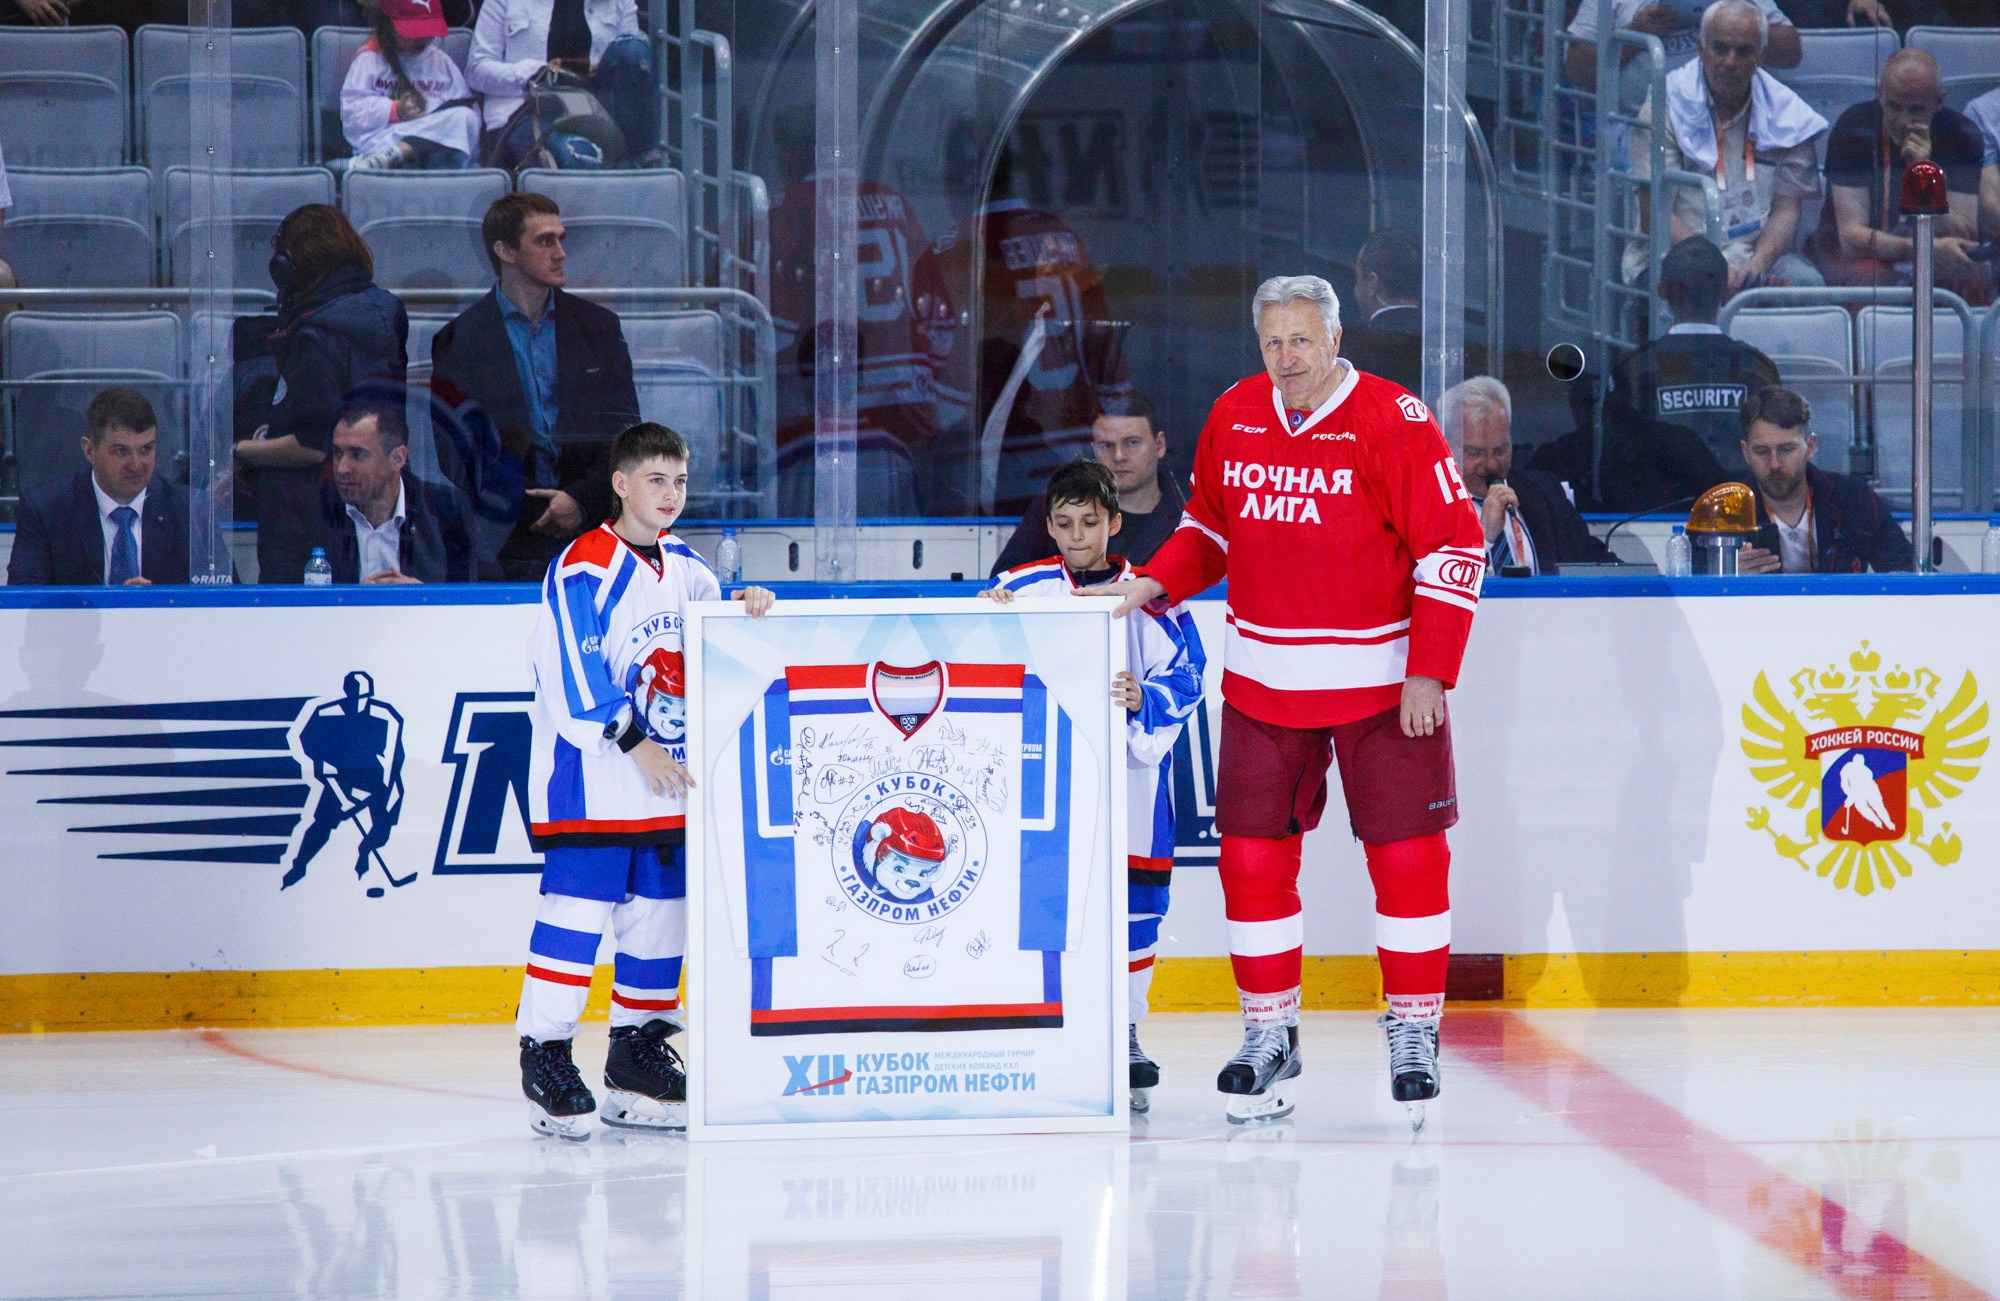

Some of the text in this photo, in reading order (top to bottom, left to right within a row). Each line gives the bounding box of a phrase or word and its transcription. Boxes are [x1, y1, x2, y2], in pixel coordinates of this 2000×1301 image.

[1662, 389, 1742, 409] SECURITY
[1232, 424, 1267, 434] CCM
[1223, 461, 1353, 494] НОЧНАЯ
[1434, 457, 1468, 504] 15
[1240, 493, 1321, 524] ЛИГА
[200, 575, 232, 584] RAITA
[1811, 728, 1919, 752] ХОККЕЙ РОССИИ
[877, 776, 946, 797] КУБОК
[842, 869, 979, 921] ГАЗПРОМ НЕФТИ
[857, 1053, 929, 1072] КУБОК
[934, 1049, 1005, 1059] МЕЖДУНАРОДНЫЙ
[781, 1055, 847, 1096] XII
[934, 1063, 967, 1071] ДЕТСКИХ
[857, 1072, 1036, 1095] ГАЗПРОМ НЕФТИ
